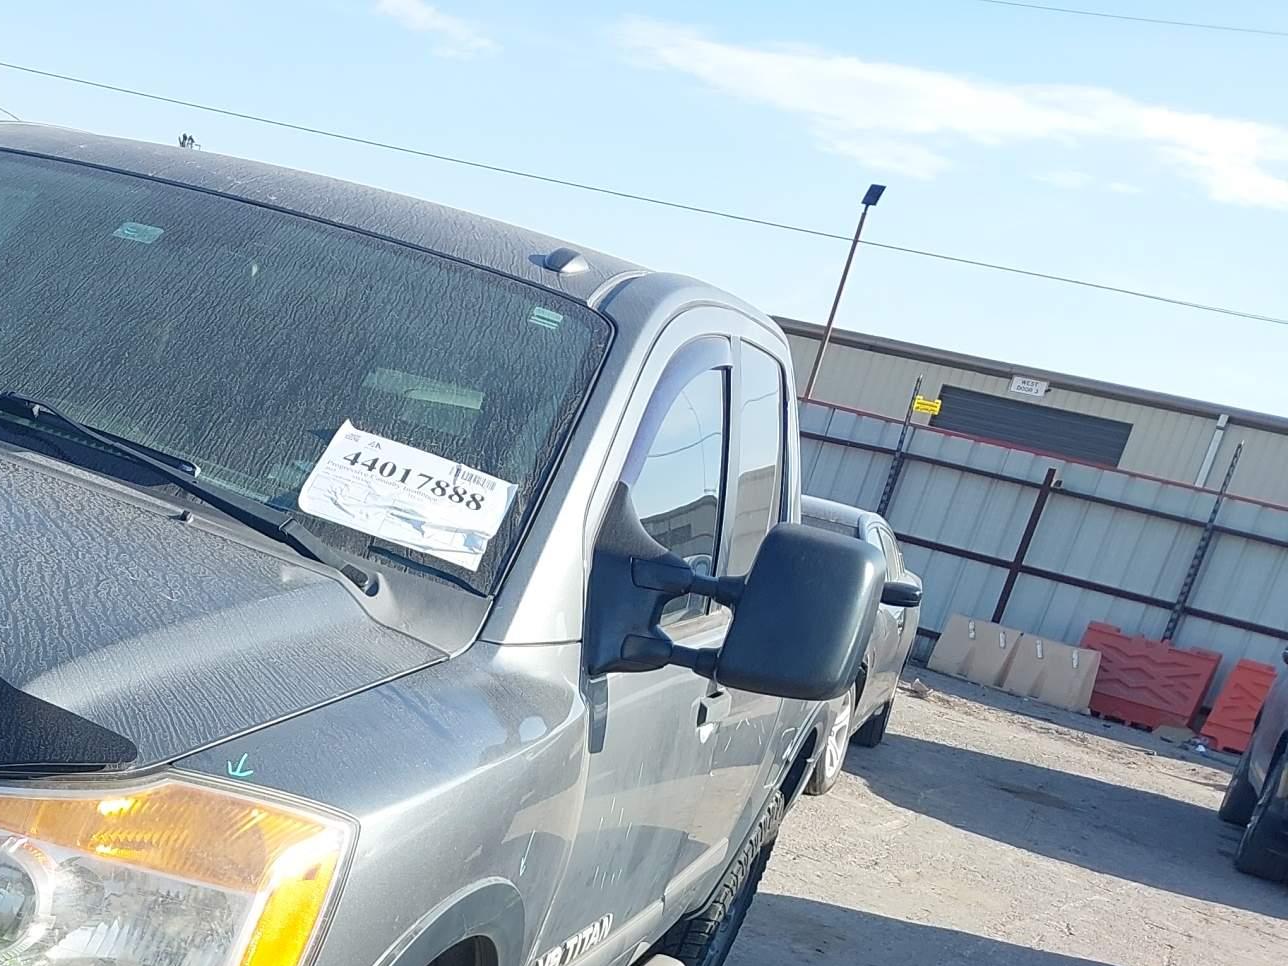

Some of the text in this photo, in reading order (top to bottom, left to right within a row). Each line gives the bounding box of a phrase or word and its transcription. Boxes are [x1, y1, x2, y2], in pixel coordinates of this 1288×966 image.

[1021, 380, 1039, 388] WEST
[343, 450, 485, 511] 44017888
[561, 912, 614, 966] TITAN
